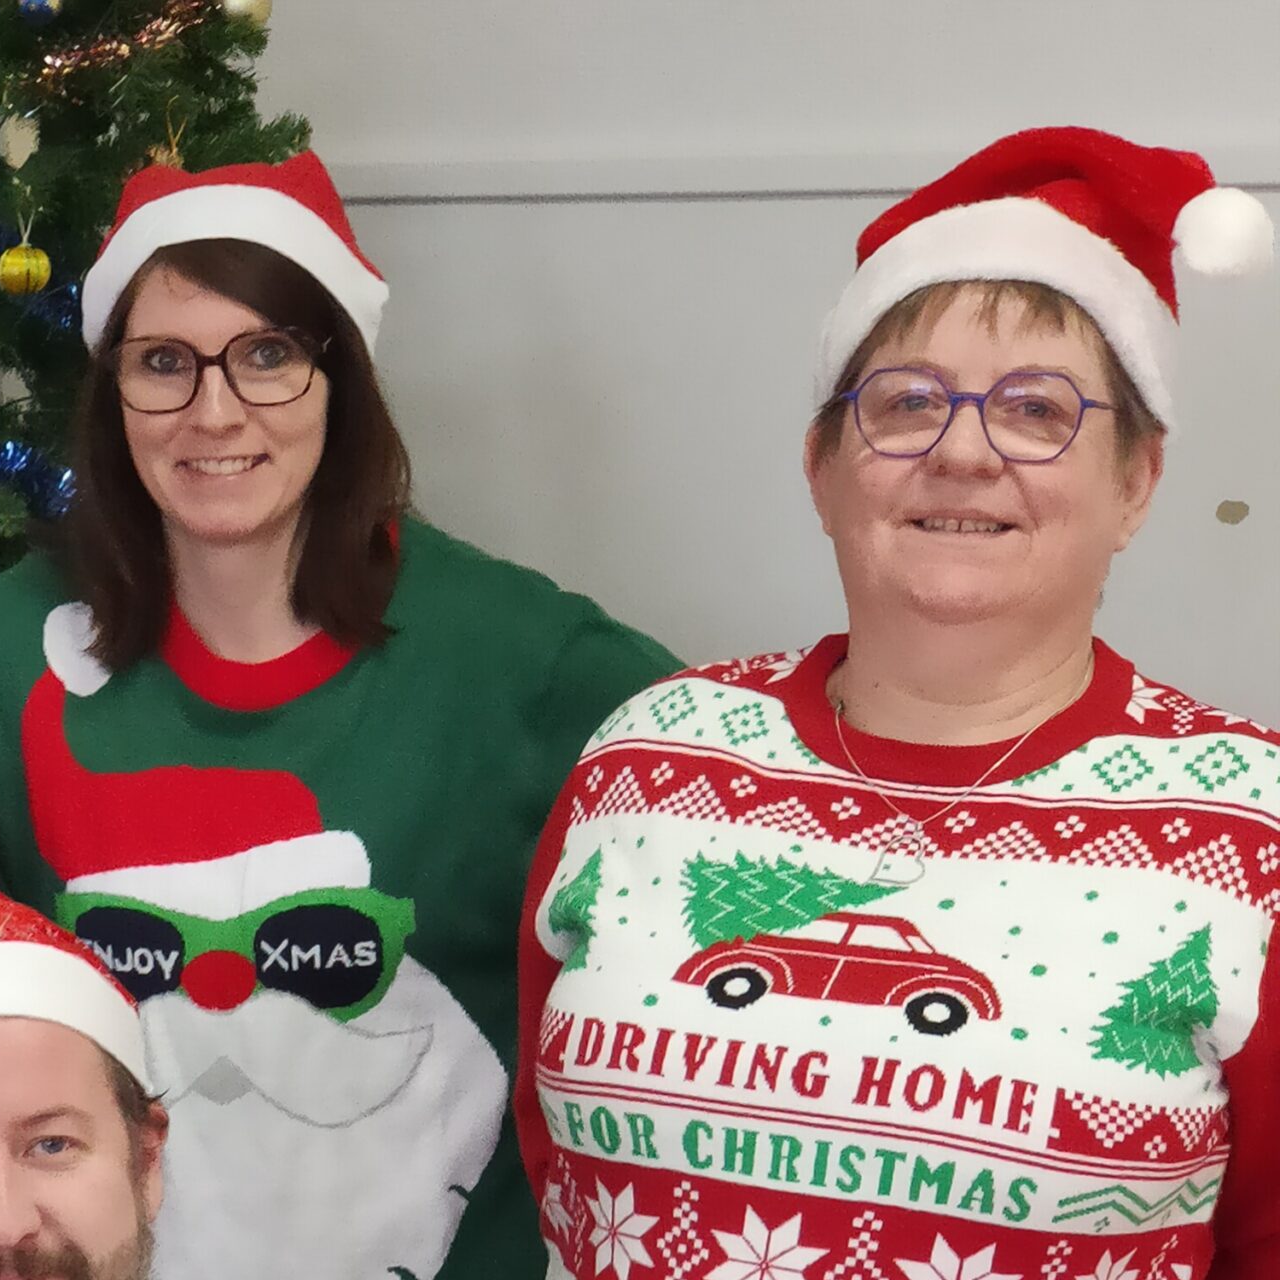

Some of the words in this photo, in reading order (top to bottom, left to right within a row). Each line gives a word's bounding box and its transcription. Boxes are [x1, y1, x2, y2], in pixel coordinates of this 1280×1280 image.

[81, 939, 179, 980] NJOY
[260, 938, 377, 972] XMAS
[574, 1017, 830, 1099] DRIVING
[852, 1056, 1038, 1134] HOME
[564, 1101, 659, 1160] FOR
[681, 1119, 1038, 1222] CHRISTMAS
